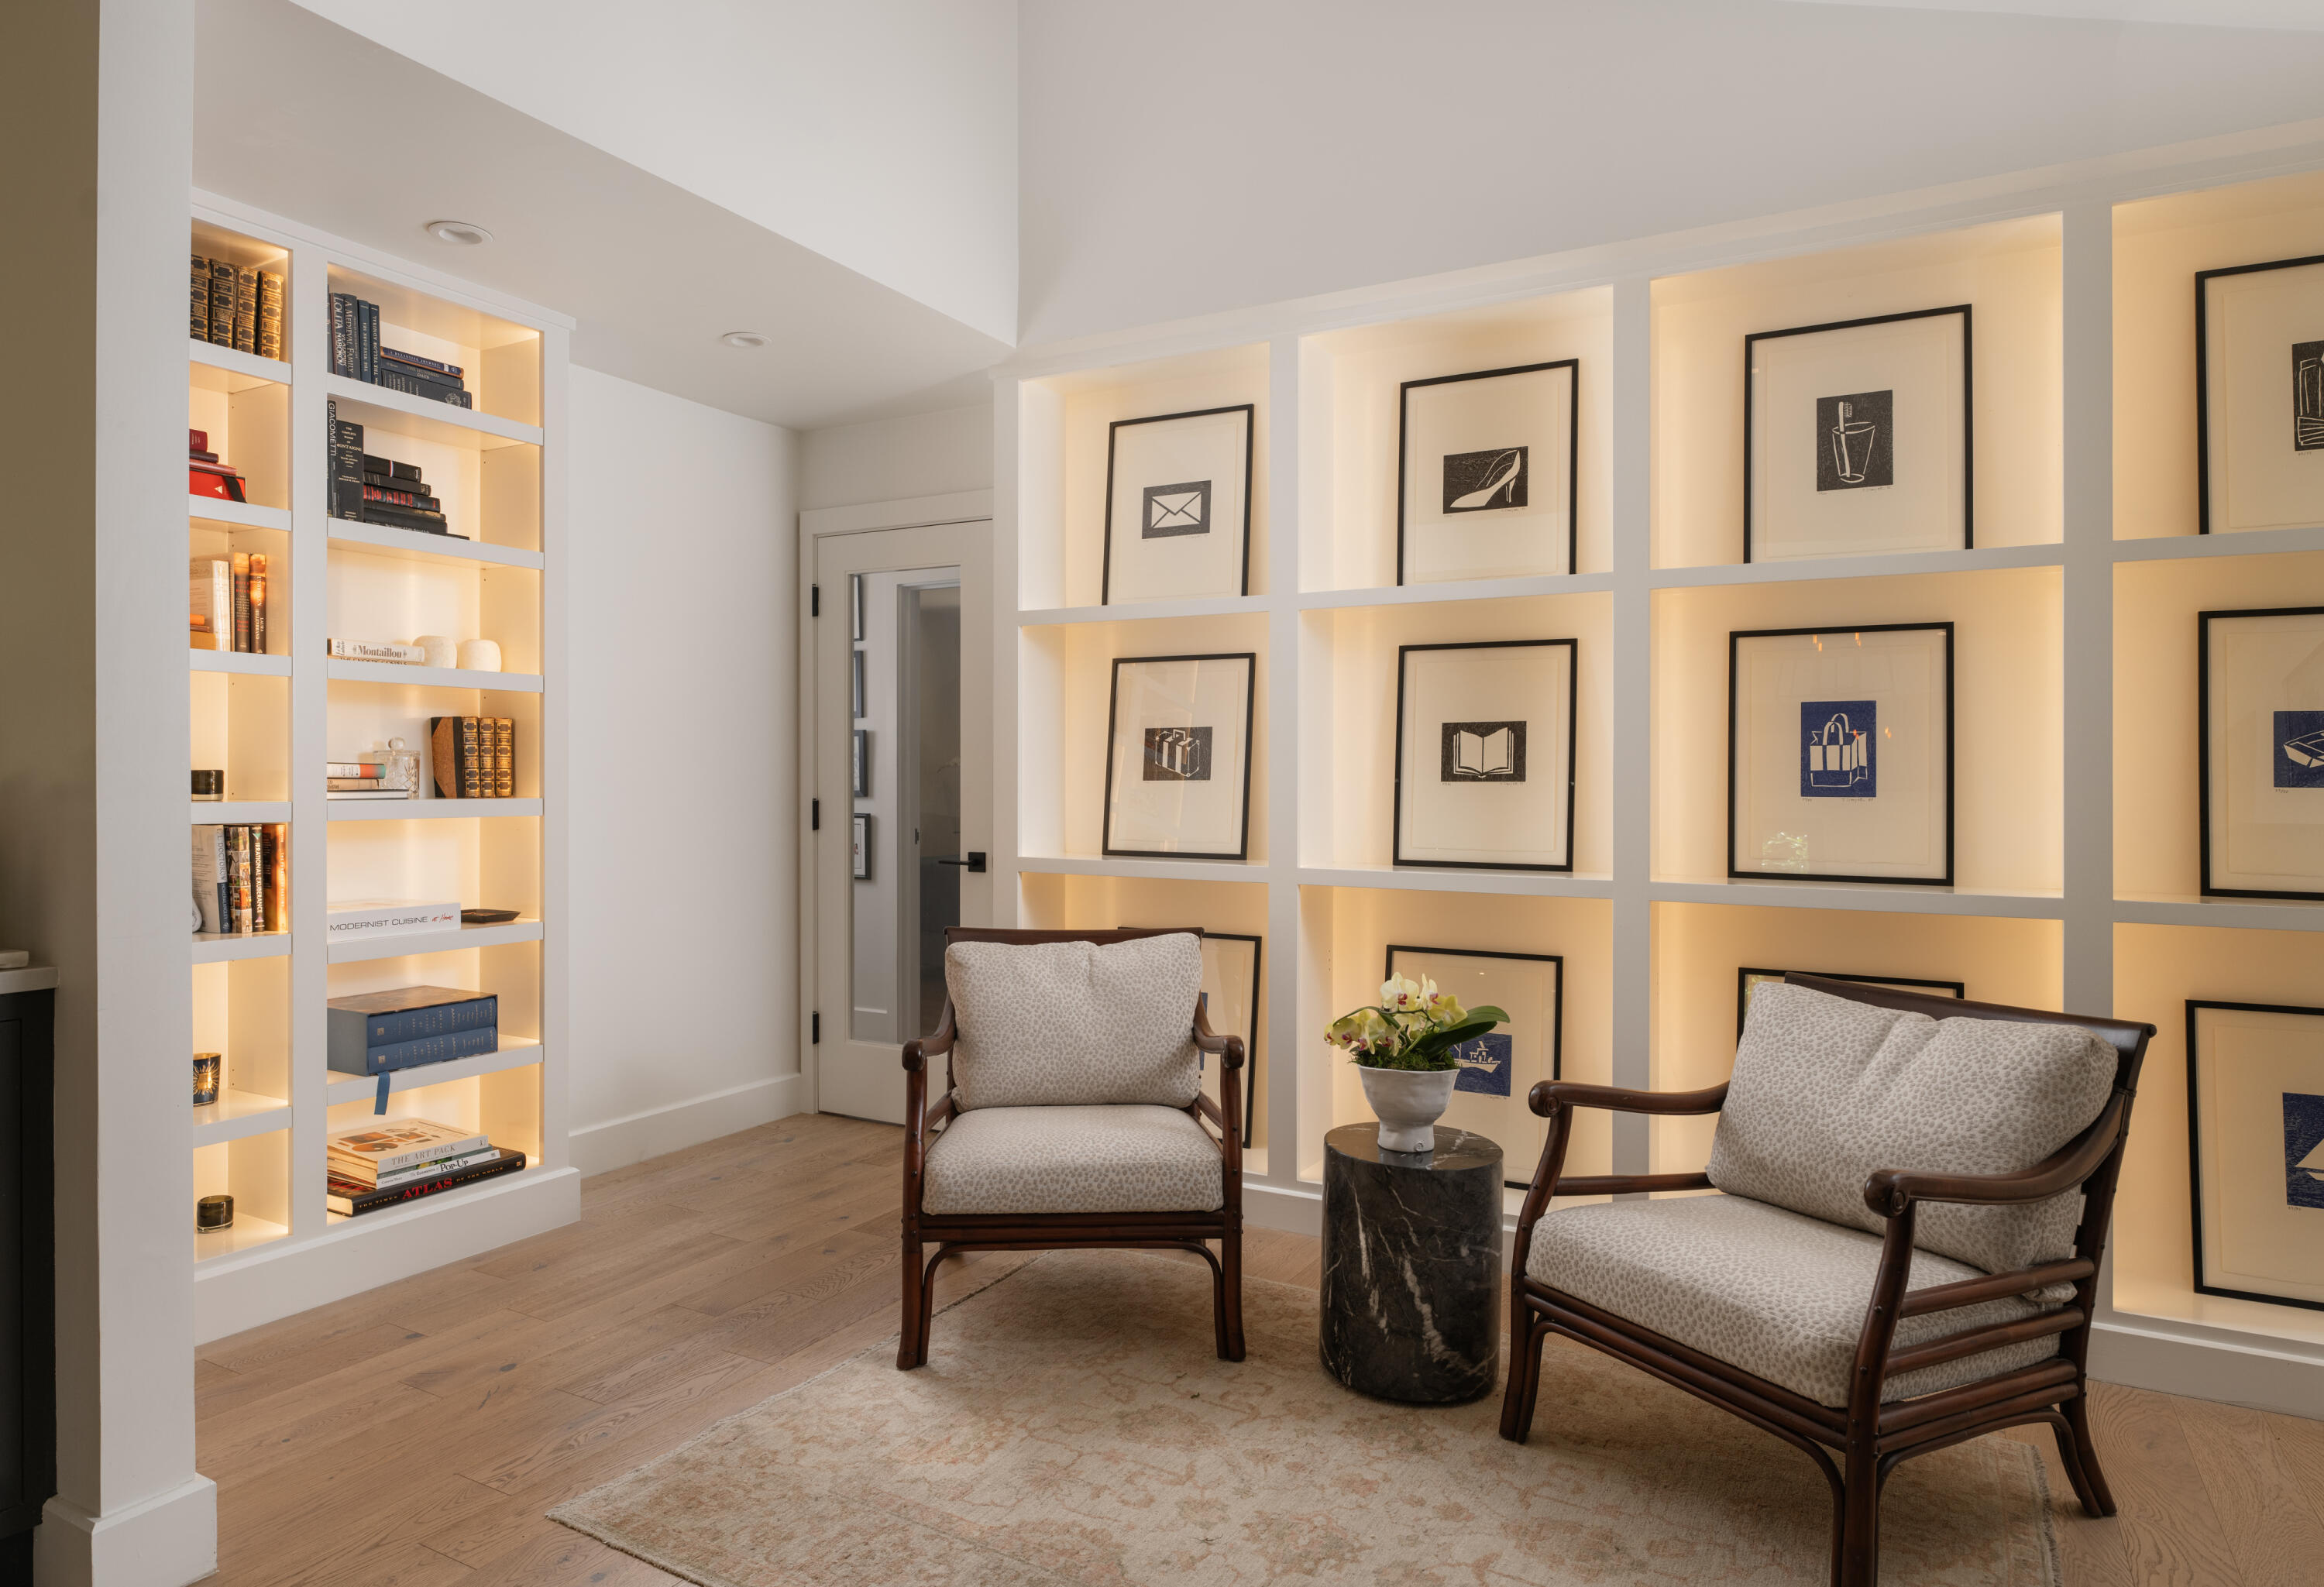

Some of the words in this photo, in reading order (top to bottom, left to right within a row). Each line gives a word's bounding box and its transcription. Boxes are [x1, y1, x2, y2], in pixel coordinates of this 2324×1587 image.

[334, 297, 344, 328] LOLITA
[345, 310, 353, 345] MEDIEVAL
[328, 403, 337, 456] GIACOMETTI
[336, 443, 362, 452] MONTAIGNE
[358, 644, 402, 658] Montaillou
[218, 843, 227, 881] DOCTOROW
[329, 919, 390, 932] MODERNIST
[391, 916, 428, 926] CUISINE
[391, 1155, 410, 1166] THE
[414, 1149, 433, 1161] ART
[434, 1144, 456, 1156] PACK
[402, 1177, 453, 1200] ATLAS
[481, 1166, 504, 1175] WORLD
